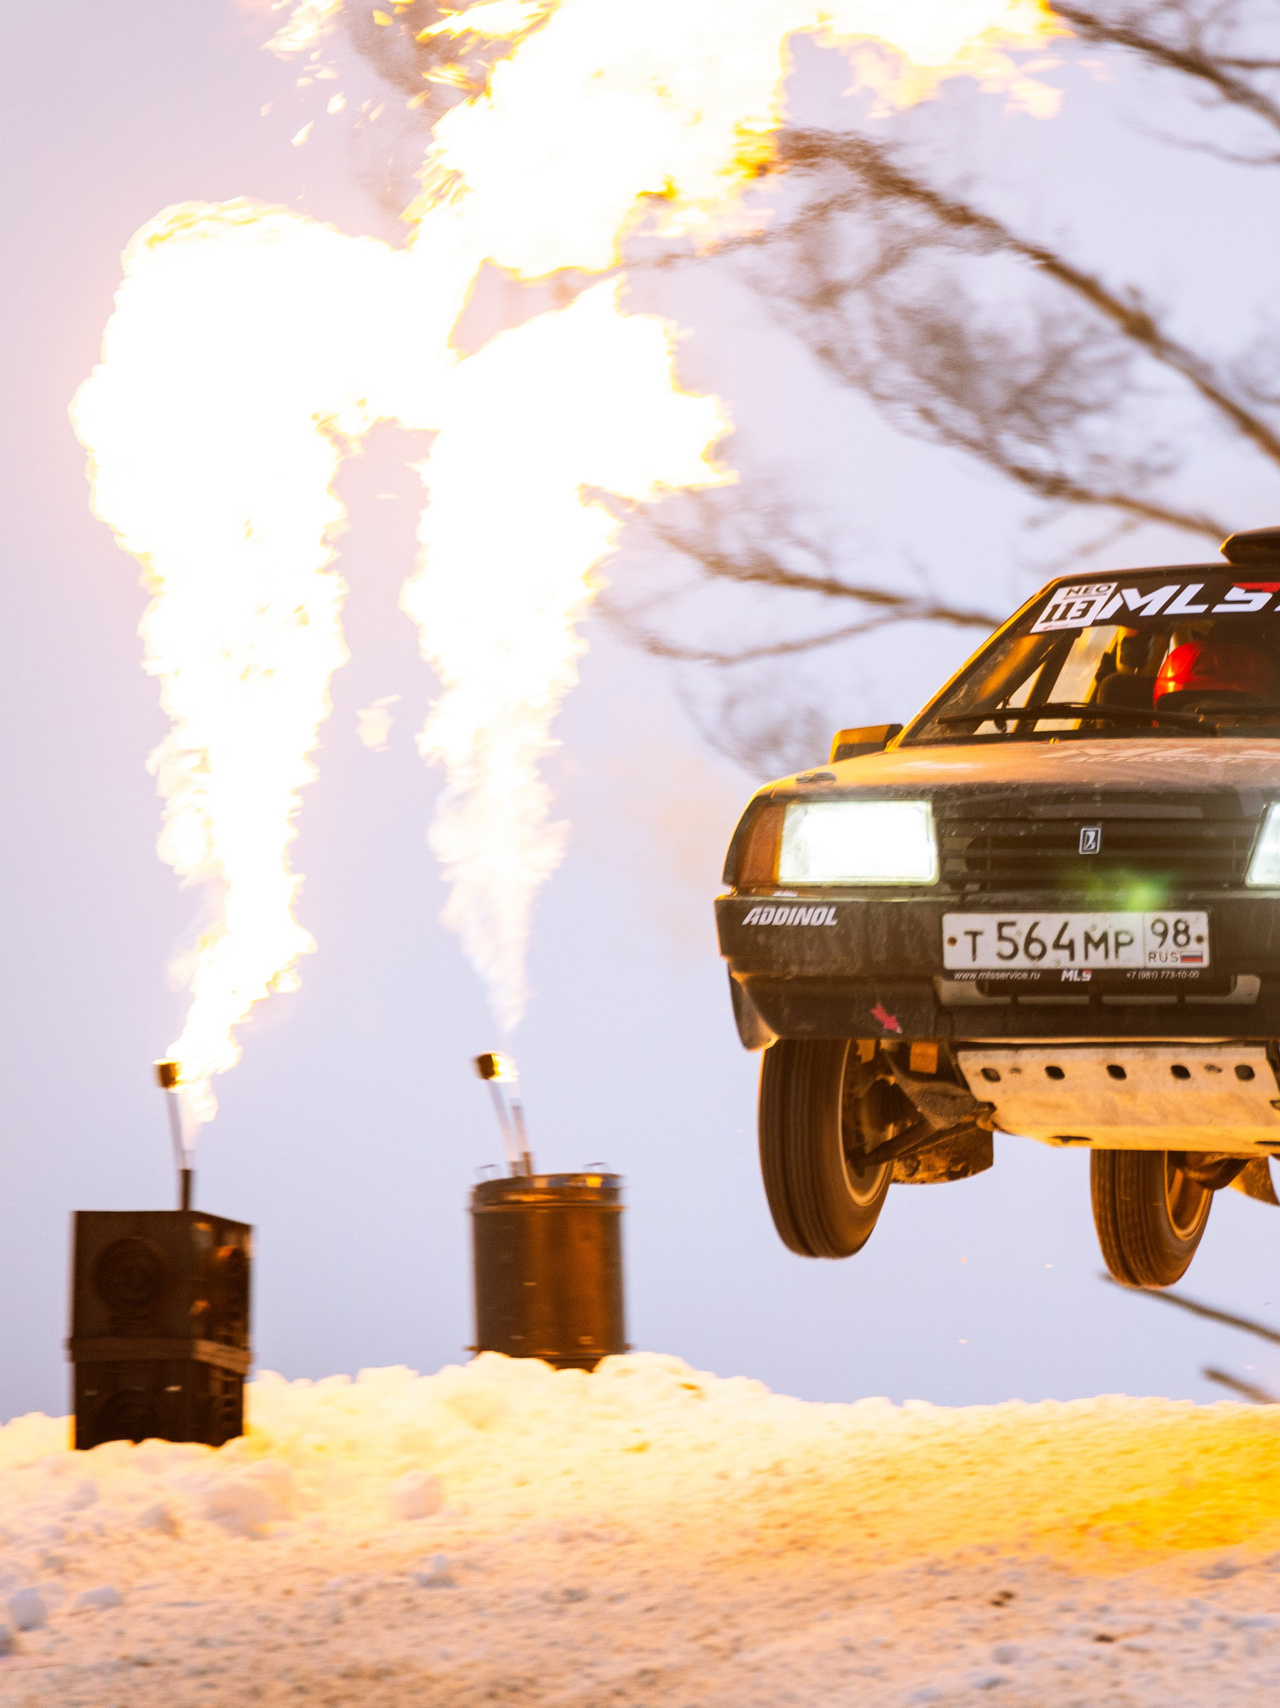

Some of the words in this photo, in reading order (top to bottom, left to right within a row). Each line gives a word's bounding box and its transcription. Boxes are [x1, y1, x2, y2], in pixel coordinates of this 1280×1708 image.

[1064, 584, 1112, 598] NEO
[741, 906, 839, 926] ADDINOL
[1150, 918, 1191, 949] 98
[1148, 952, 1179, 964] RUS
[1060, 968, 1093, 982] MLS
